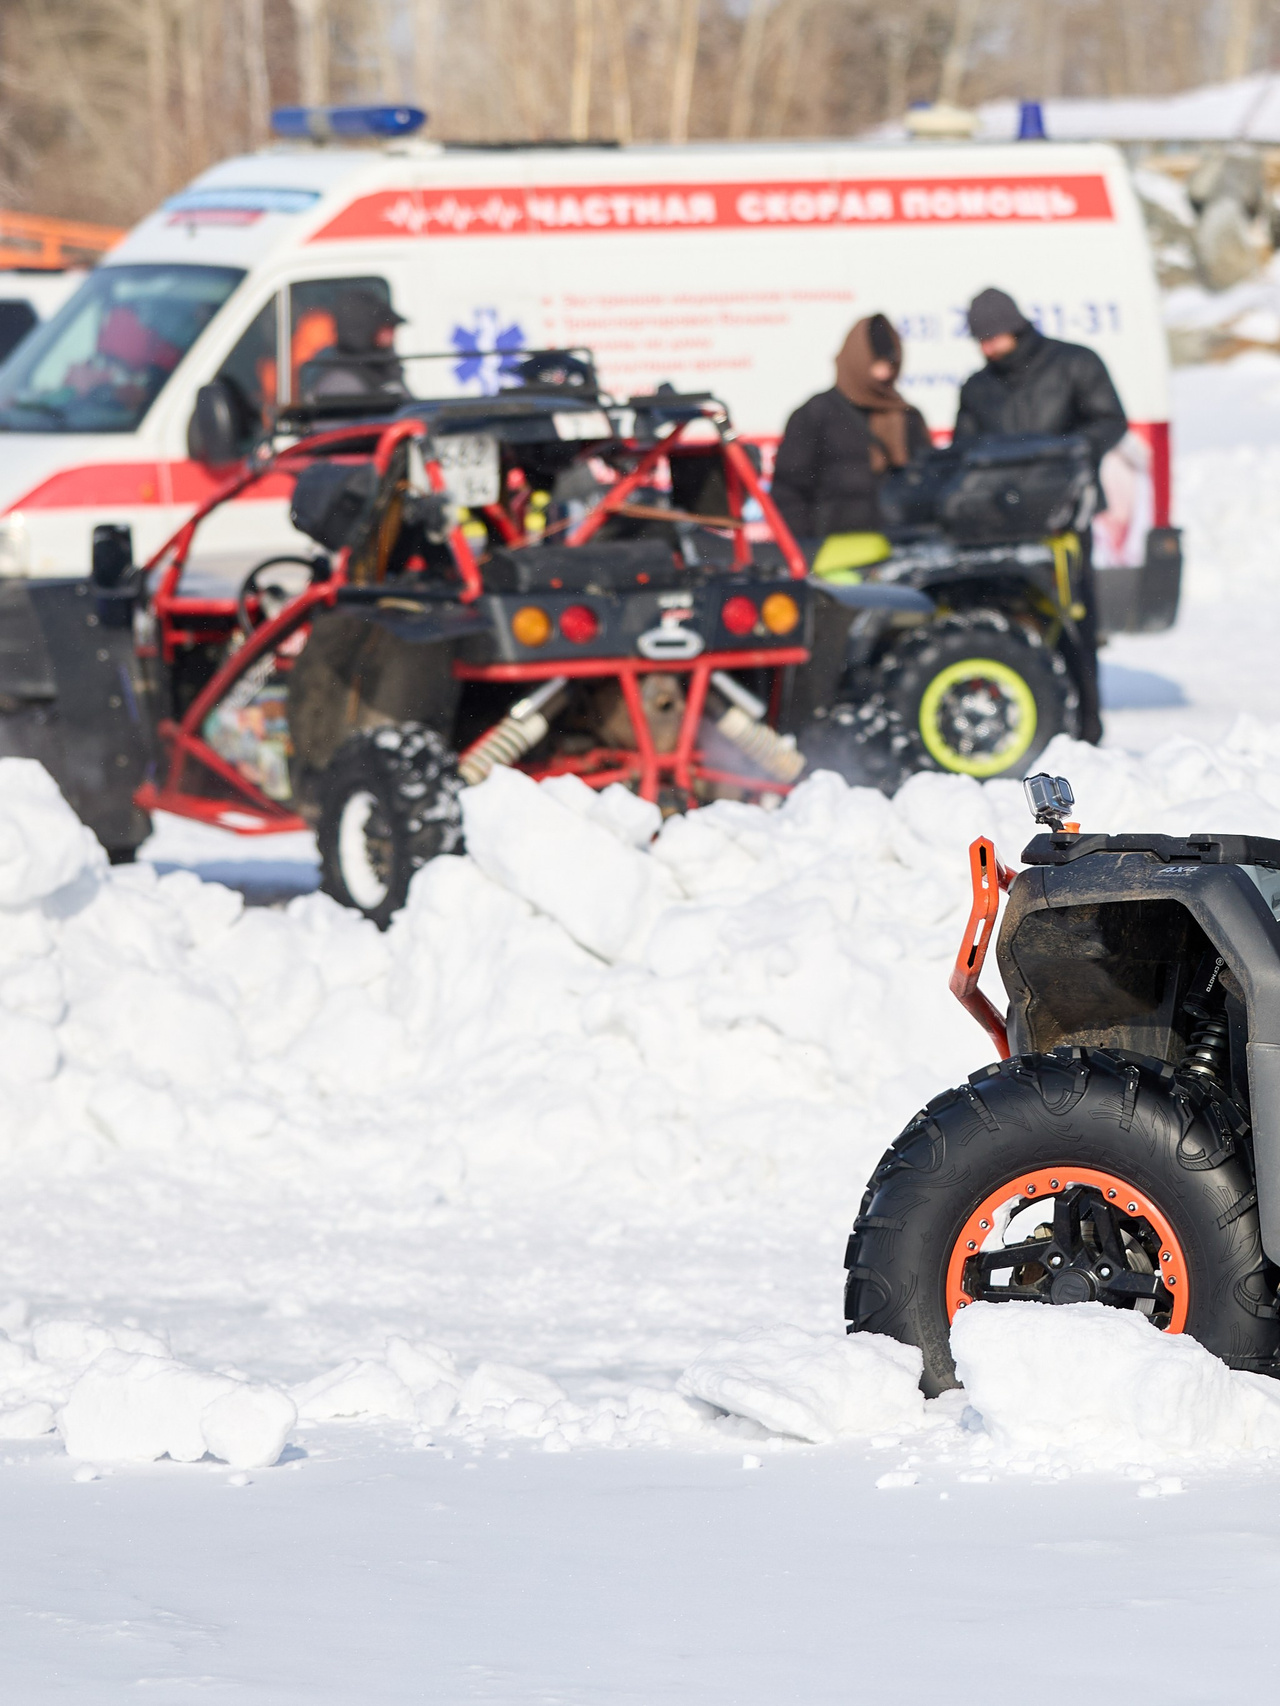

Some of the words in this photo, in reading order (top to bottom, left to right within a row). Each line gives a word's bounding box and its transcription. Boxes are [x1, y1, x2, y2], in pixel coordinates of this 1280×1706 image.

[528, 192, 717, 227] ЧАСТНАЯ
[736, 190, 894, 223] СКОРАЯ
[901, 186, 1078, 222] ПОМОЩЬ
[1205, 965, 1221, 993] CFMOTO
